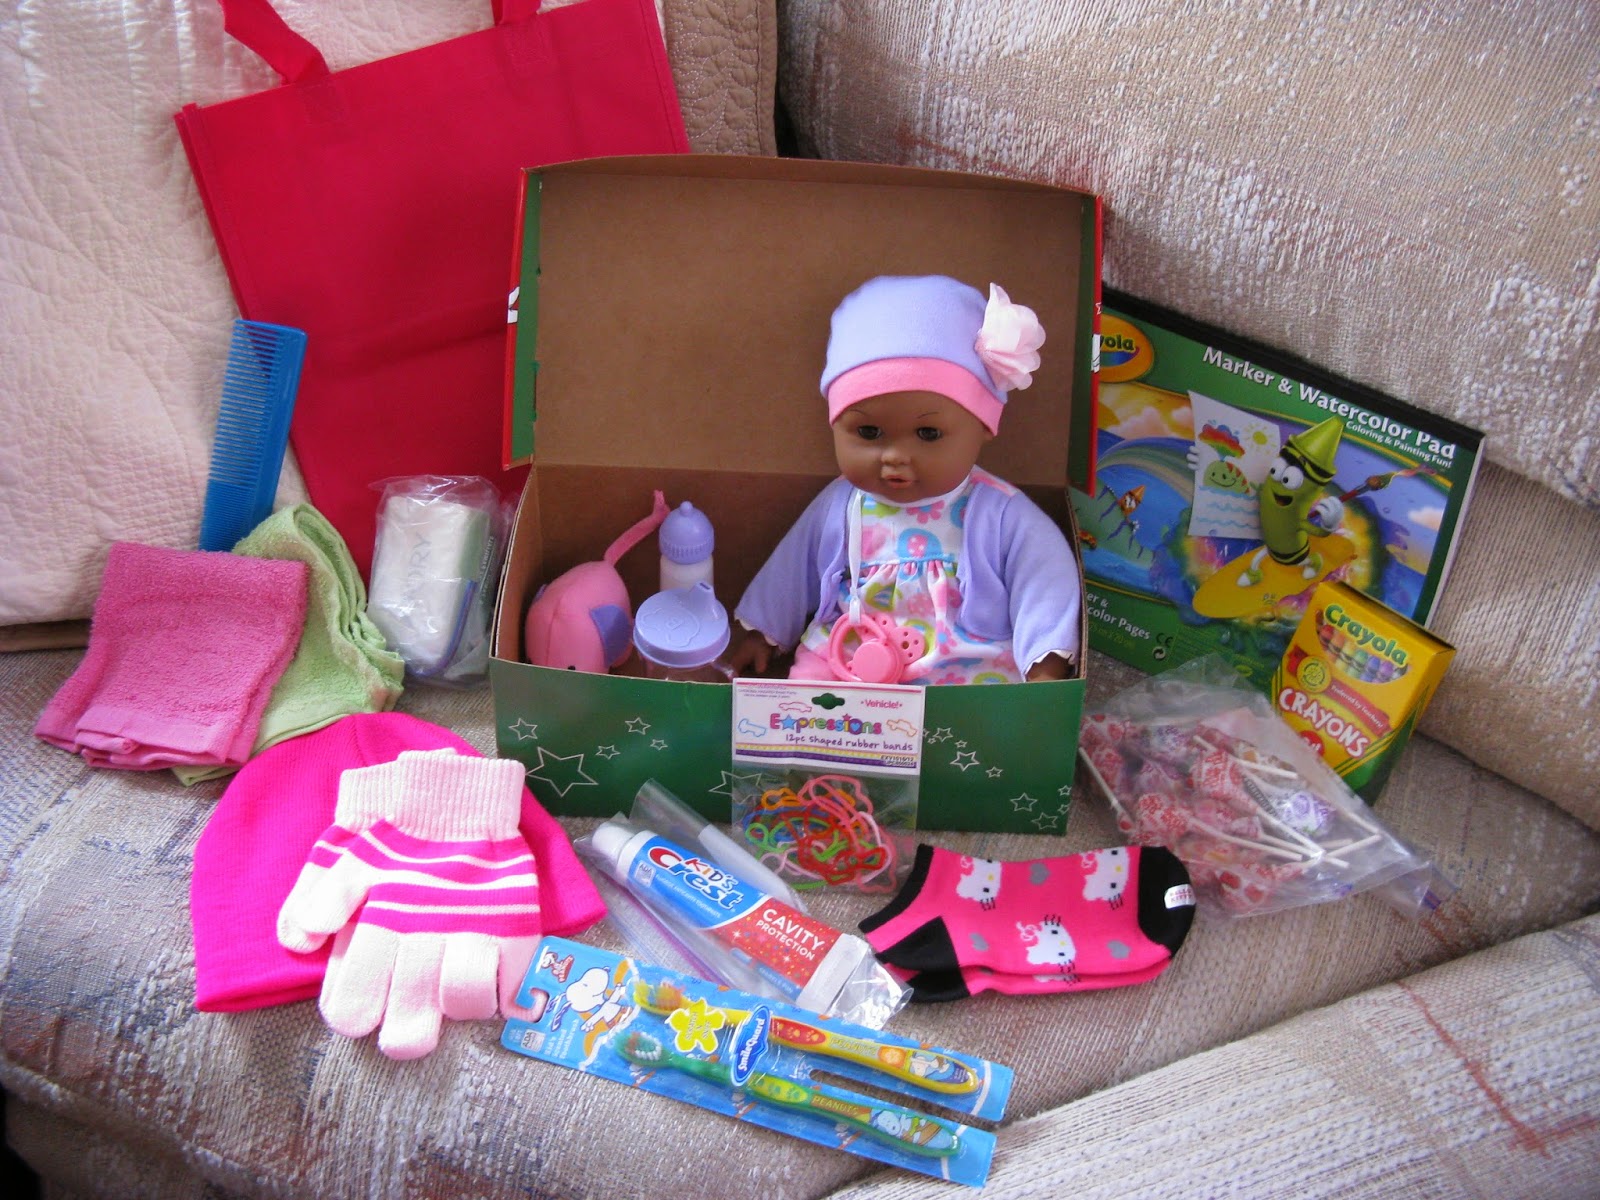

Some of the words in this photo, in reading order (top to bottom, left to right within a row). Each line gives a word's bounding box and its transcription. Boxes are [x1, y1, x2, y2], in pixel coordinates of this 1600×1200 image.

[1203, 346, 1275, 386] Marker
[1278, 378, 1294, 395] &
[1299, 382, 1412, 440] Watercolor
[1416, 431, 1457, 459] Pad
[1346, 421, 1384, 443] Coloring
[1384, 437, 1392, 445] &
[1394, 440, 1430, 462] Painting
[1432, 455, 1453, 468] Fun!
[1100, 598, 1109, 608] &
[1118, 617, 1151, 640] Pages
[1326, 604, 1408, 666] Crayola
[786, 733, 806, 744] 12pc
[809, 735, 842, 748] shaped
[846, 738, 879, 749] rubber
[883, 741, 913, 751] bands
[1279, 687, 1370, 757] CRAYONS
[648, 846, 744, 910] Crest
[756, 920, 816, 961] PROTECTION
[762, 908, 825, 951] CAVITY
[738, 1018, 765, 1072] SmileGuard
[812, 1094, 859, 1116] PEANUTS
